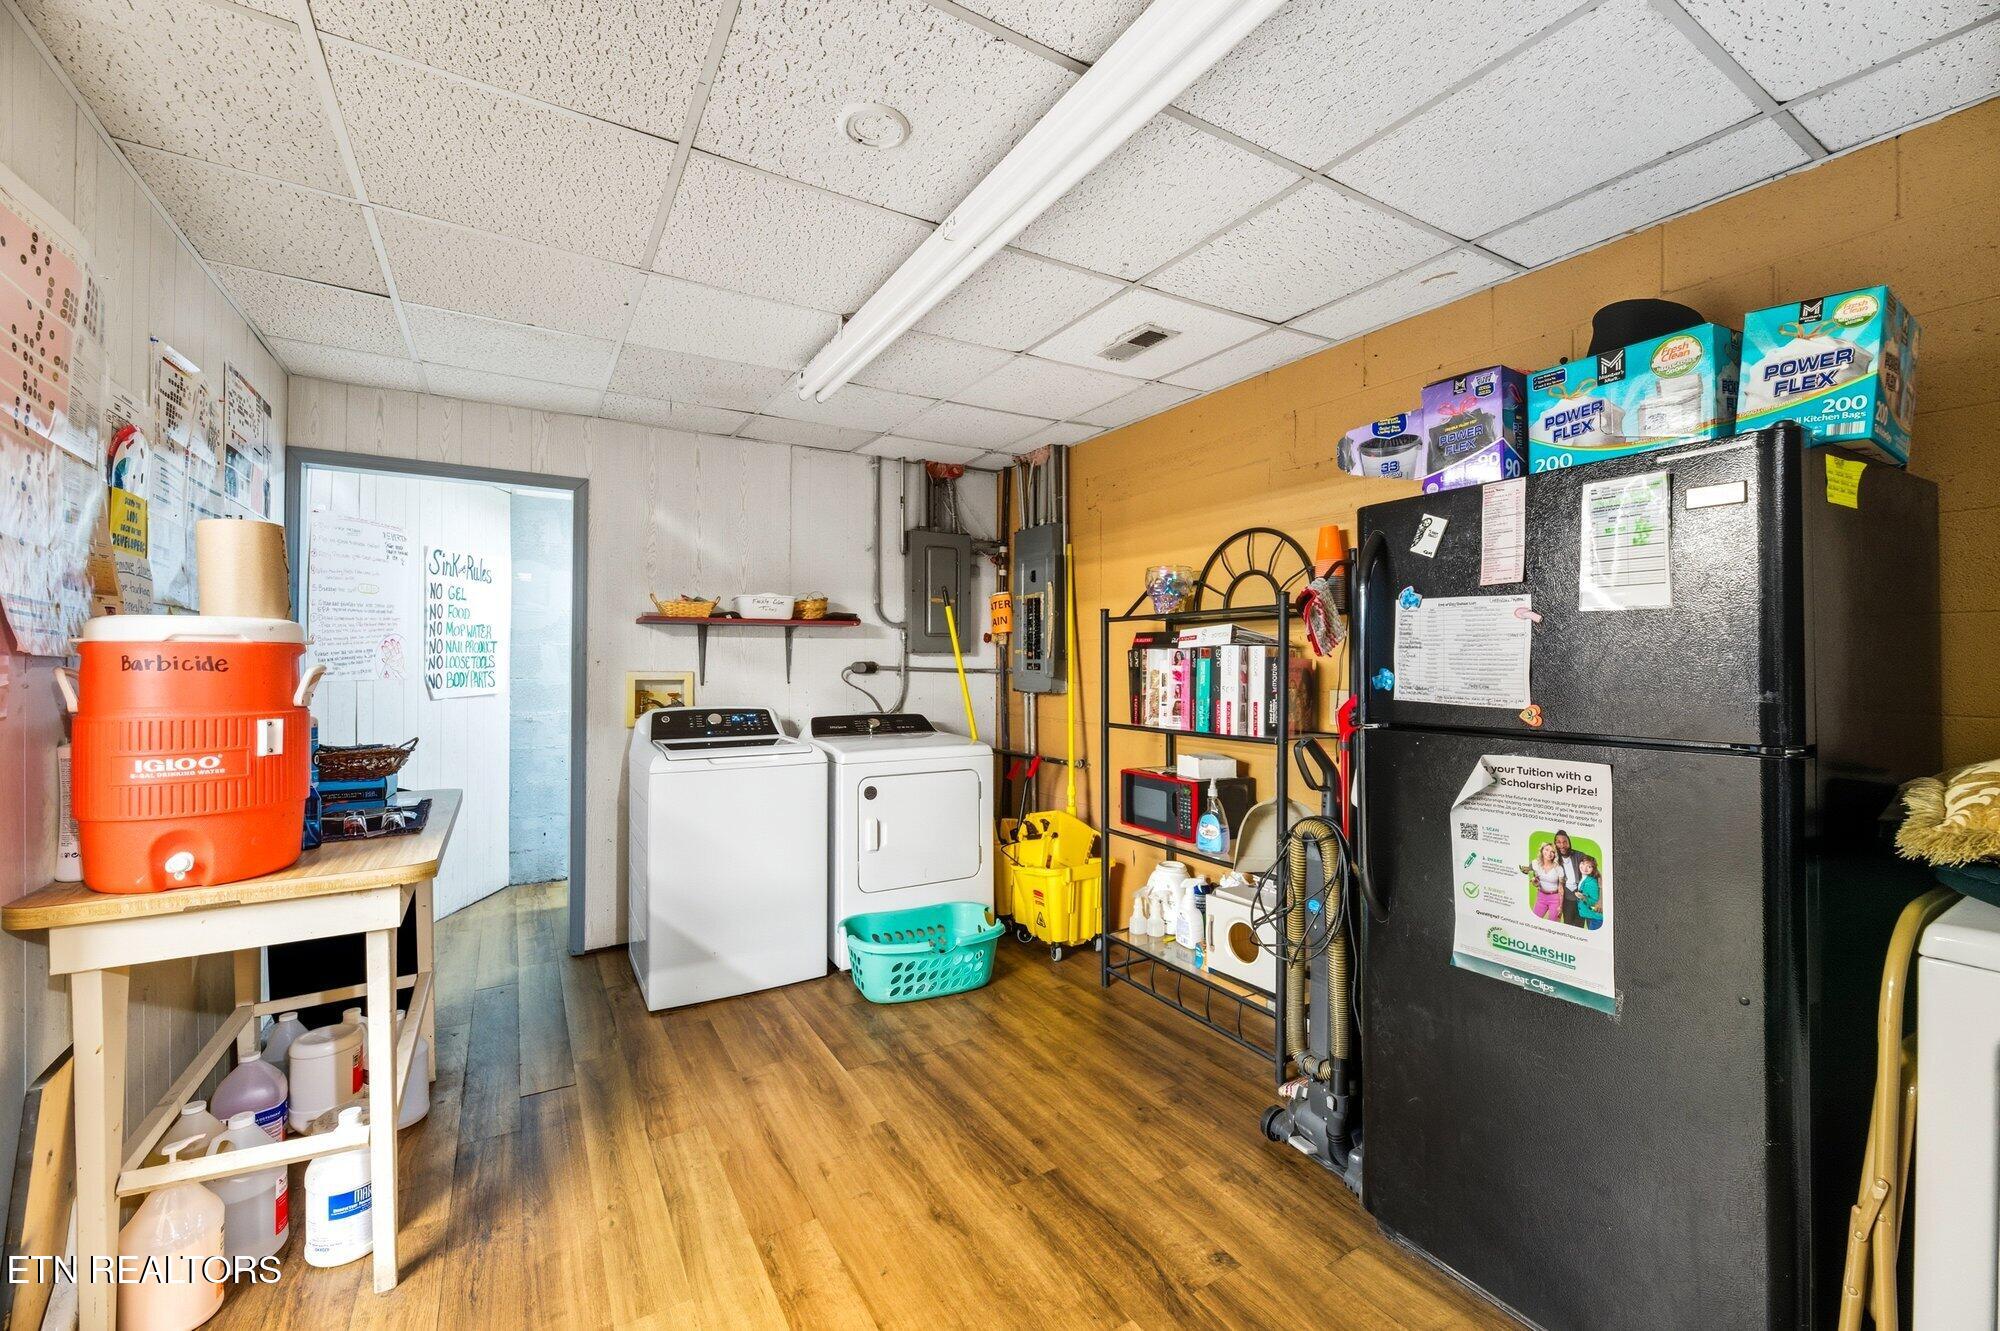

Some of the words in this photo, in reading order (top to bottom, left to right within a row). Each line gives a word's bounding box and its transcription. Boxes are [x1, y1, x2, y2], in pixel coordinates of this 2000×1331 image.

[1661, 342, 1689, 356] Fresh
[1661, 350, 1690, 362] Clean
[1763, 347, 1855, 381] POWER
[1773, 369, 1839, 398] FLEX
[1821, 394, 1868, 414] 200
[1545, 400, 1605, 431] POWER
[1803, 414, 1840, 423] Kitchen
[1842, 410, 1866, 420] Bags
[1439, 424, 1484, 447] POWER
[1552, 418, 1595, 443] FLEX
[1445, 438, 1477, 456] FLEX
[1380, 460, 1400, 473] 33
[1505, 457, 1521, 478] 90
[1535, 453, 1573, 473] 200
[466, 555, 492, 584] Rules
[430, 582, 443, 599] NO
[448, 585, 467, 600] GEL
[429, 603, 443, 620] NO
[448, 604, 471, 619] FOOD
[429, 621, 443, 637] NO
[446, 621, 465, 636] MOP
[466, 624, 492, 639] WATER
[992, 616, 1008, 627] AIN
[429, 638, 443, 655] NO
[121, 655, 229, 672] Barbicide
[428, 655, 443, 670] NO
[445, 655, 470, 669] LOOSE
[471, 655, 495, 669] TOOLS
[428, 673, 442, 689] NO
[446, 670, 470, 688] BODY
[471, 670, 496, 688] PARTS
[134, 755, 221, 774] IGLOO
[1491, 766, 1515, 774] your
[1517, 766, 1554, 779] Tuition
[1556, 770, 1581, 781] with
[1500, 777, 1563, 794] Scholarship
[1566, 784, 1598, 797] Prize!
[1492, 933, 1576, 964] SCHOLARSHIP
[1501, 970, 1530, 985] Great
[1531, 978, 1555, 993] Clips
